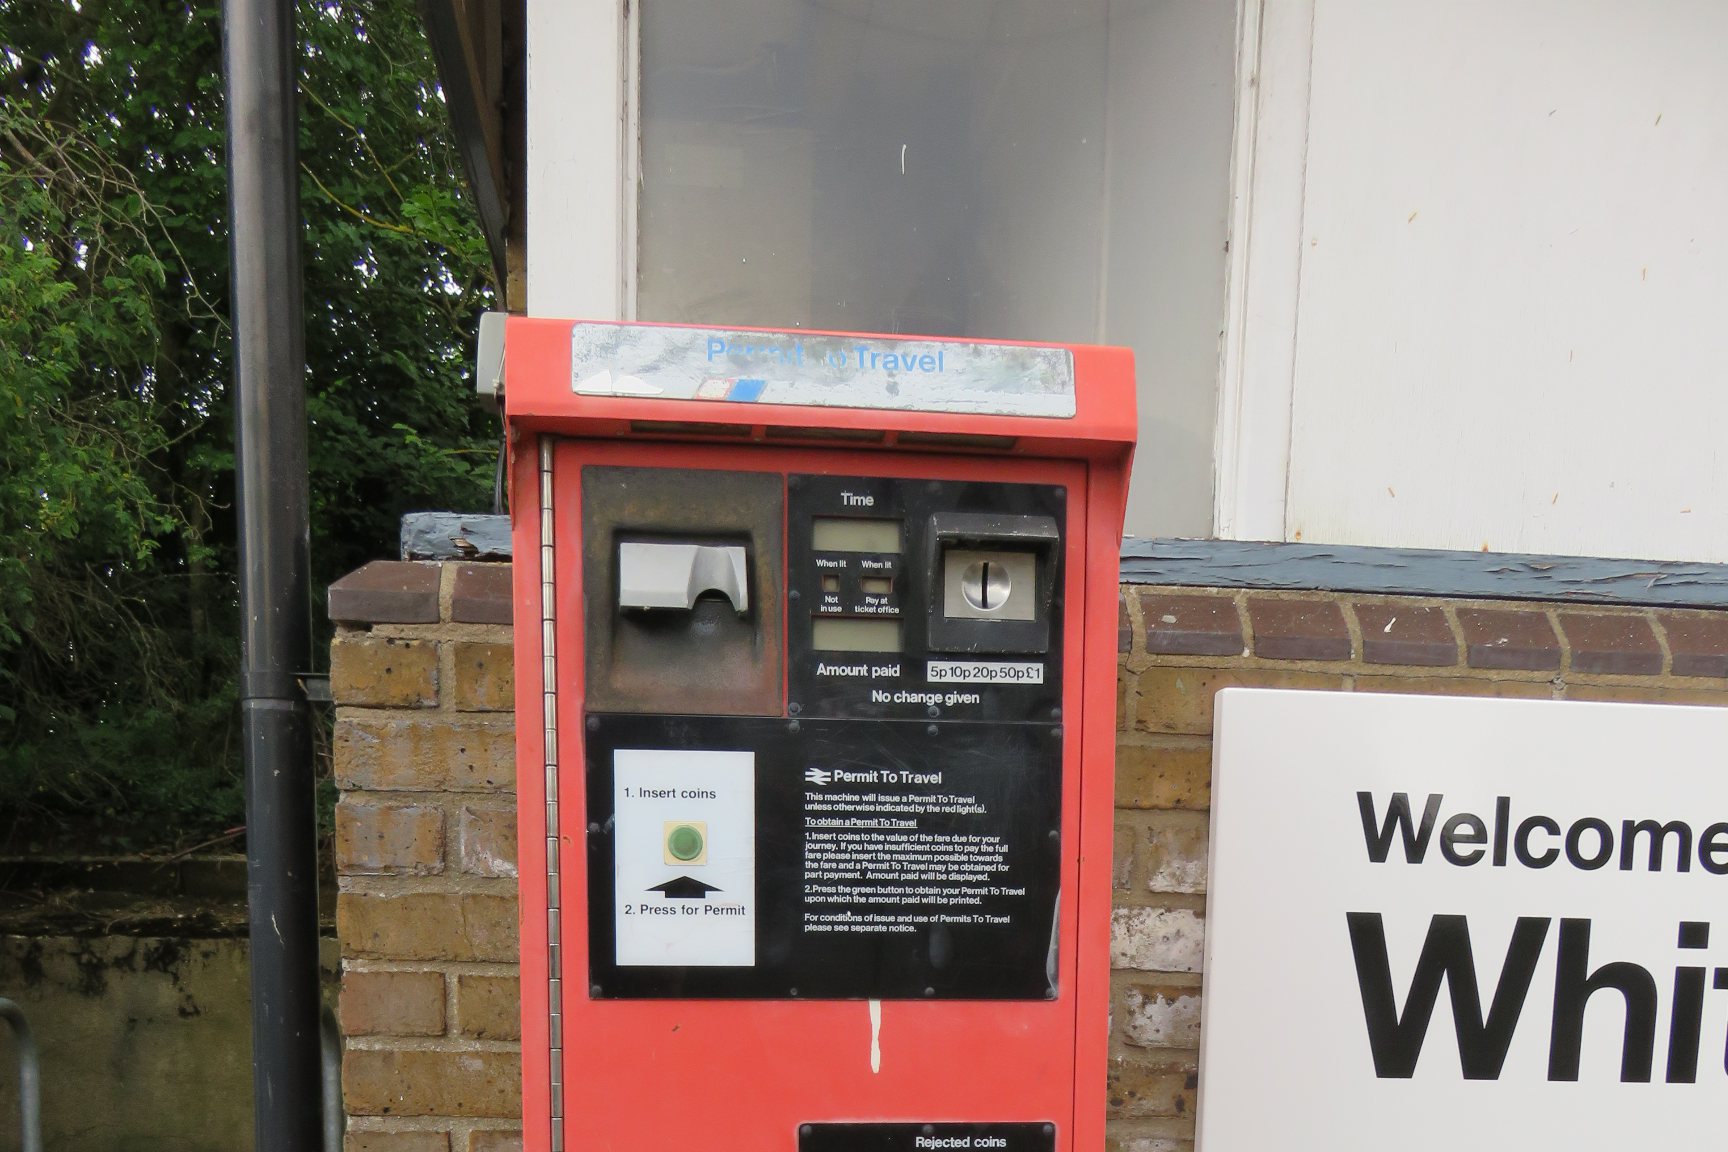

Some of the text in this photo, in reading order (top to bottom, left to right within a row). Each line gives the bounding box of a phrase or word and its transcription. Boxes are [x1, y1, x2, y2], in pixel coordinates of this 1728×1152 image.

[853, 346, 944, 373] Travel
[840, 492, 874, 506] Time
[815, 559, 847, 568] When lit
[861, 560, 892, 569] When lit
[824, 595, 839, 603] Not
[865, 596, 879, 605] Pay
[820, 604, 828, 612] in
[877, 606, 900, 614] office
[816, 662, 900, 679] Amount paid
[930, 666, 1040, 681] 5p 10p 20p 50p £1
[872, 690, 980, 706] No change given
[834, 769, 942, 785] Permit To Travel
[623, 787, 717, 799] 1. Insert coins
[805, 792, 823, 801] This
[824, 793, 860, 801] machine
[862, 793, 876, 802] will
[878, 794, 900, 802] issue
[908, 794, 936, 803] Permit
[937, 795, 948, 803] To
[948, 795, 975, 804] Travel
[805, 802, 987, 816] unless otherwise indicated by the red light(s).
[805, 817, 816, 826] To
[817, 817, 844, 826] obtain
[850, 818, 878, 826] Permit
[879, 818, 890, 827] To
[890, 818, 917, 827] Travel
[838, 832, 860, 840] coins
[871, 832, 884, 841] the
[886, 832, 908, 841] value
[909, 833, 918, 841] of
[920, 833, 933, 842] the
[934, 833, 950, 842] fare
[952, 833, 968, 842] due
[968, 834, 981, 842] for
[982, 836, 1000, 845] your
[1356, 791, 1728, 875] Welcome
[805, 841, 838, 852] journey.
[847, 843, 862, 852] you
[864, 842, 884, 850] have
[884, 842, 930, 851] insufficient
[931, 843, 954, 851] coins
[964, 845, 980, 854] pay
[980, 843, 994, 852] the
[996, 843, 1008, 852] full
[805, 851, 1004, 863] fare please insert the maximum possible towards
[805, 860, 819, 869] the
[820, 860, 837, 869] fare
[838, 861, 854, 869] and
[862, 861, 890, 870] Permit
[890, 861, 902, 870] To
[902, 862, 928, 870] Travel
[929, 864, 946, 873] may
[948, 862, 960, 871] be
[960, 862, 996, 871] obtained
[998, 863, 1010, 871] for
[805, 869, 990, 882] part payment. Amount paid will be displayed.
[838, 885, 852, 893] the
[852, 887, 876, 896] green
[878, 885, 904, 894] button
[914, 886, 941, 894] obtain
[942, 887, 960, 897] your
[962, 886, 988, 895] Permit
[990, 886, 1000, 895] To
[1000, 886, 1026, 895] Travel
[804, 894, 982, 906] upon which the amount paid will be printed.
[624, 904, 746, 916] 2. Press for Permit
[804, 913, 818, 921] For
[820, 913, 862, 922] conditions
[874, 913, 896, 922] issue
[897, 914, 912, 922] and
[940, 914, 972, 923] Permits
[972, 914, 984, 923] To
[985, 914, 1010, 923] Travel
[804, 923, 832, 934] please
[850, 923, 888, 934] separate
[888, 924, 917, 932] notice.
[1345, 911, 1728, 1084] Whi
[915, 1136, 1007, 1150] Rejected coins
